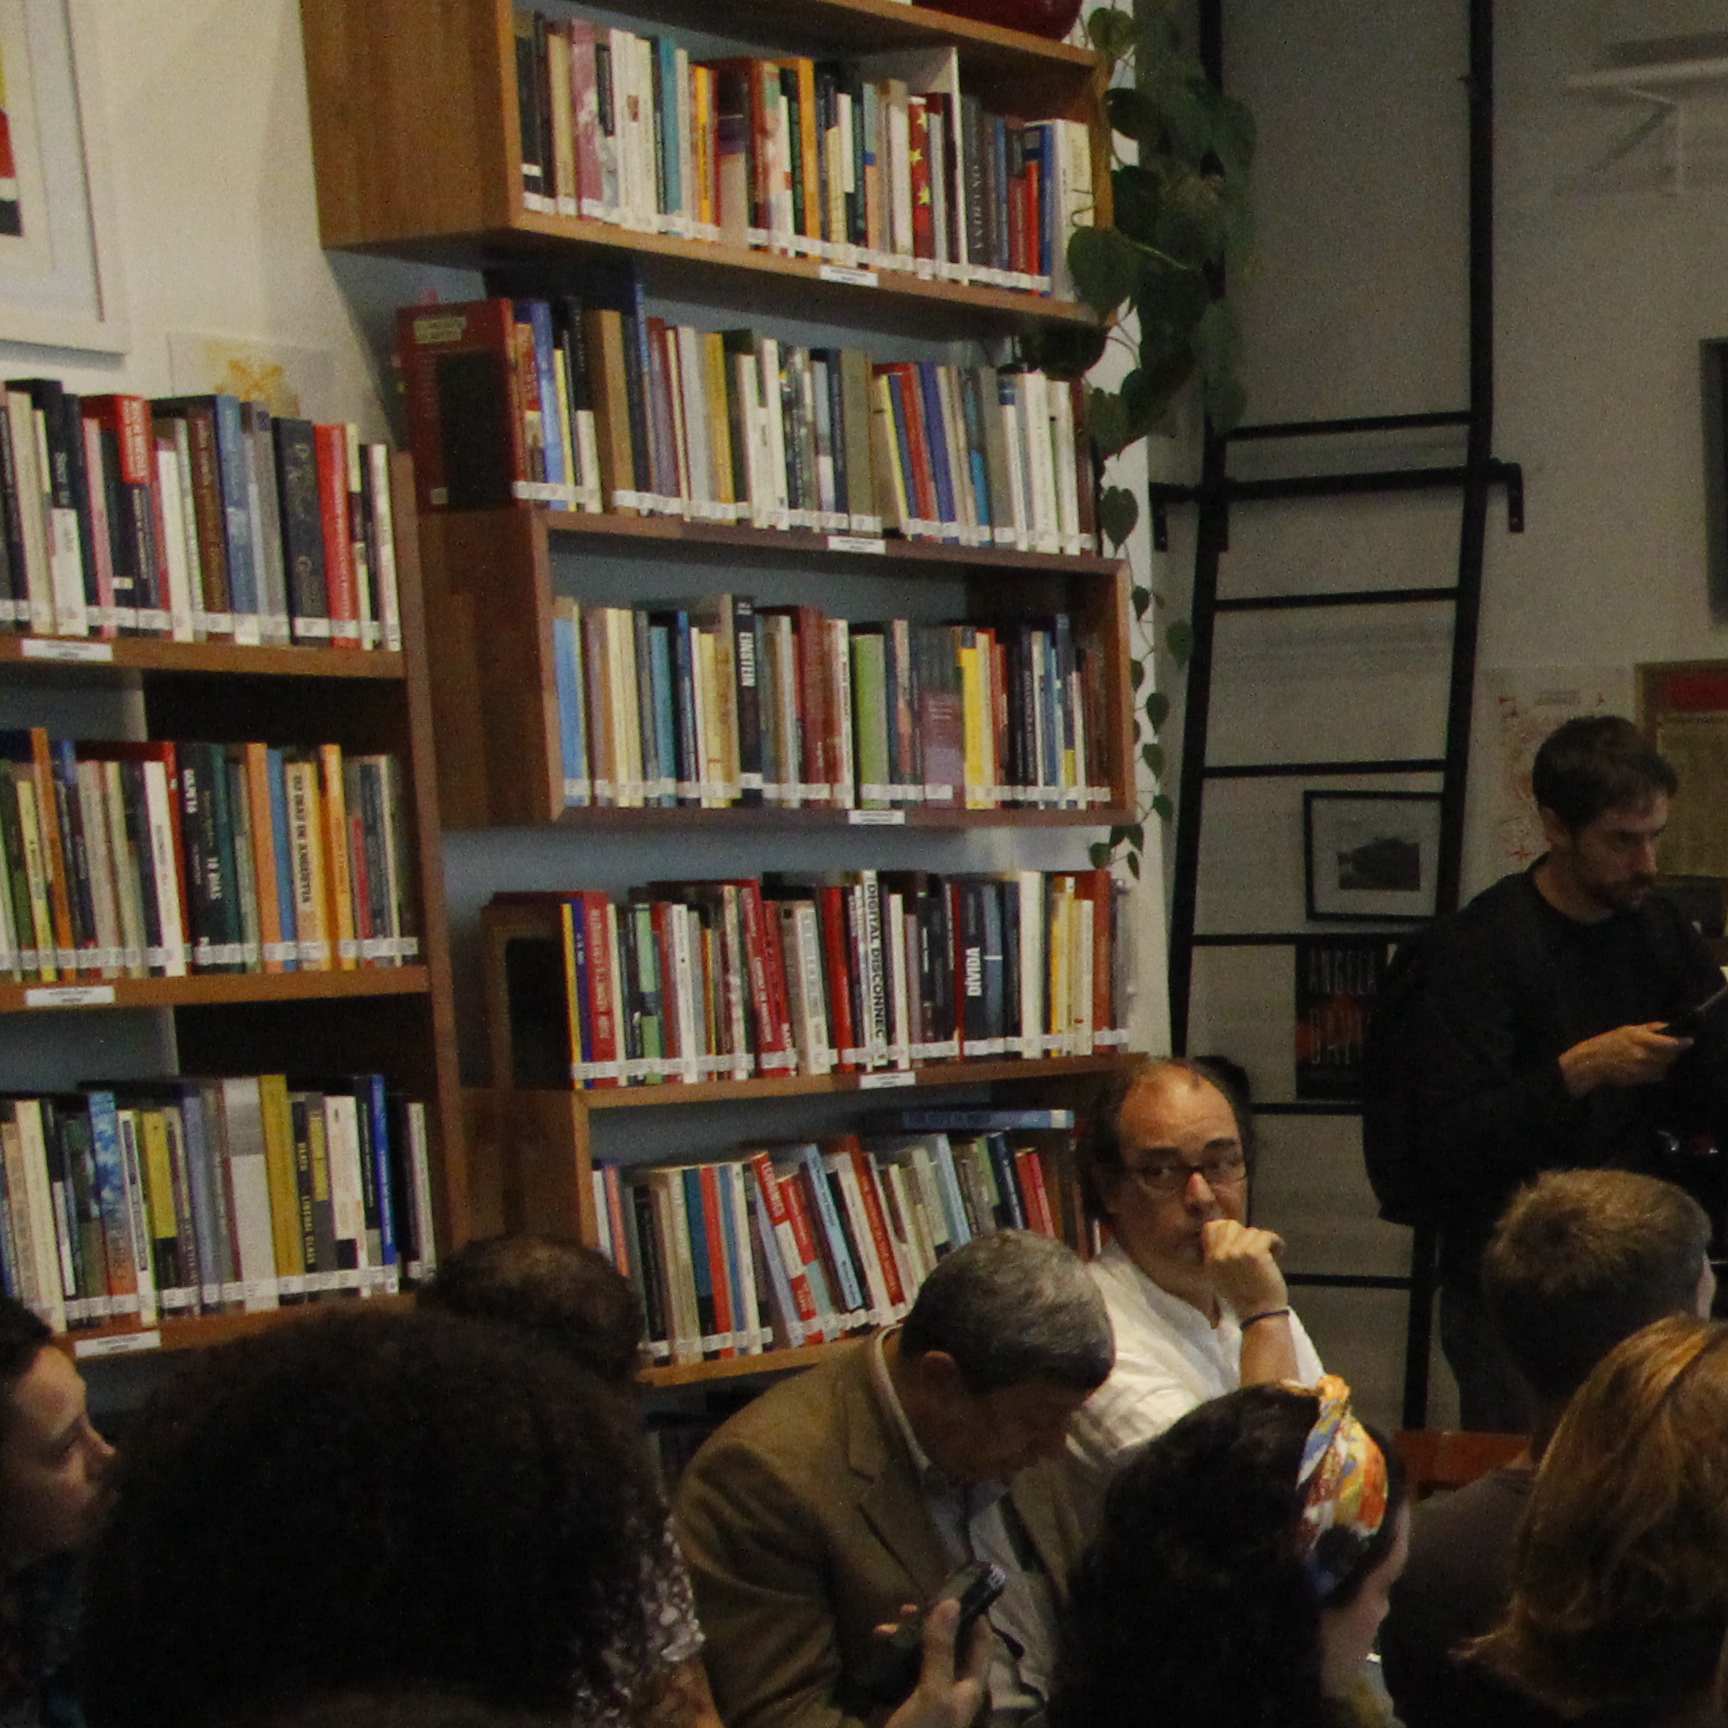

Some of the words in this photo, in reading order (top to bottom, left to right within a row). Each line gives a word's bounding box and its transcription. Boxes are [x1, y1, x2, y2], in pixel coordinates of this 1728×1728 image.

[738, 631, 756, 688] EINSTEIN
[865, 883, 881, 944] DIGITAL
[869, 947, 886, 1040] DISCONNEC
[966, 947, 982, 998] DÍVIDA
